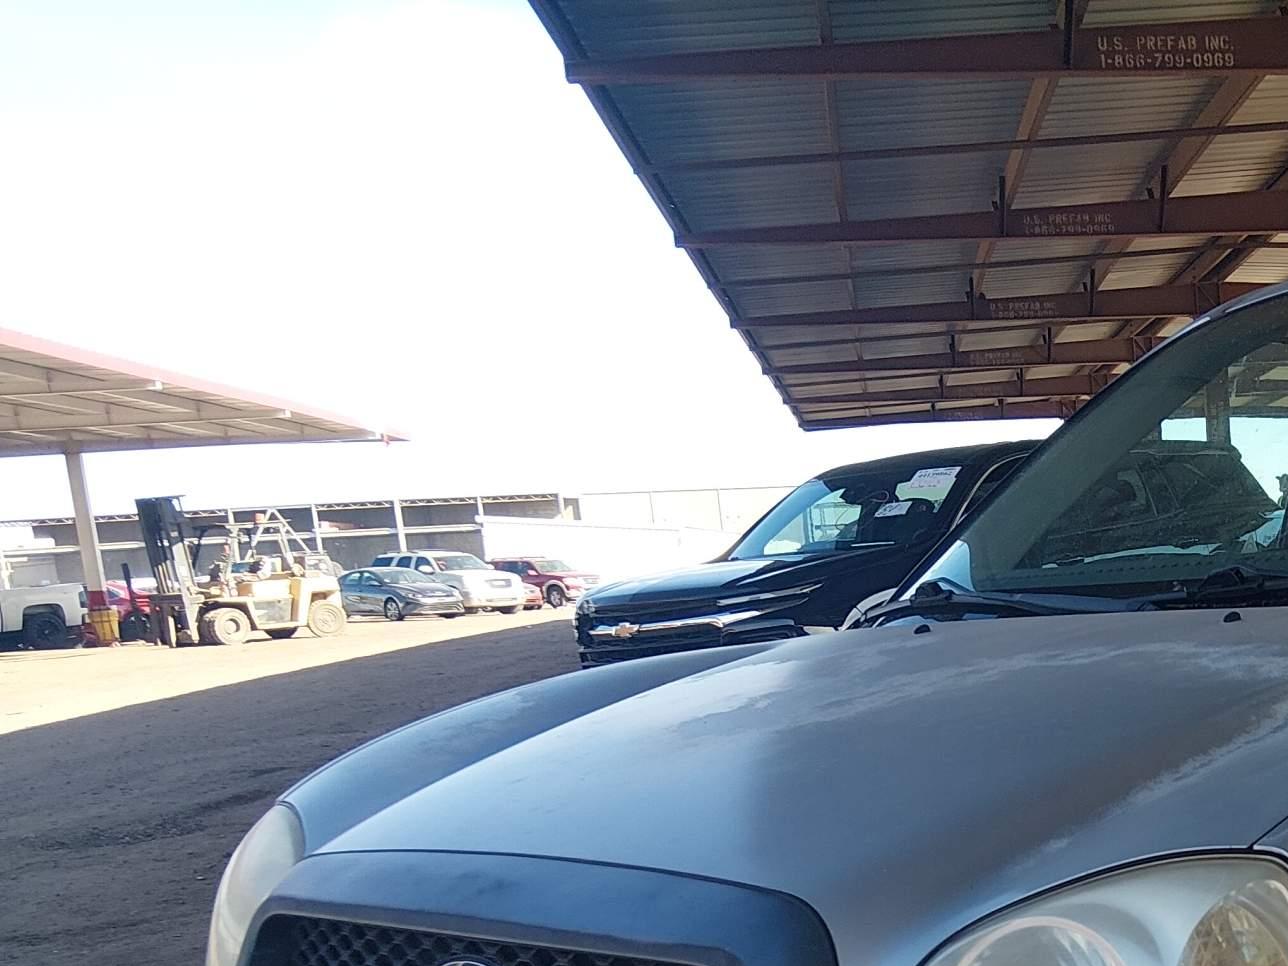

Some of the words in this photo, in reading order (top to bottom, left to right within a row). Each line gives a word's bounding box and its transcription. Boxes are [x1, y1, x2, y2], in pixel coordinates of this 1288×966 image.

[1097, 36, 1129, 50] U.S.
[1136, 35, 1197, 50] PREFAB
[1205, 35, 1235, 49] INC.
